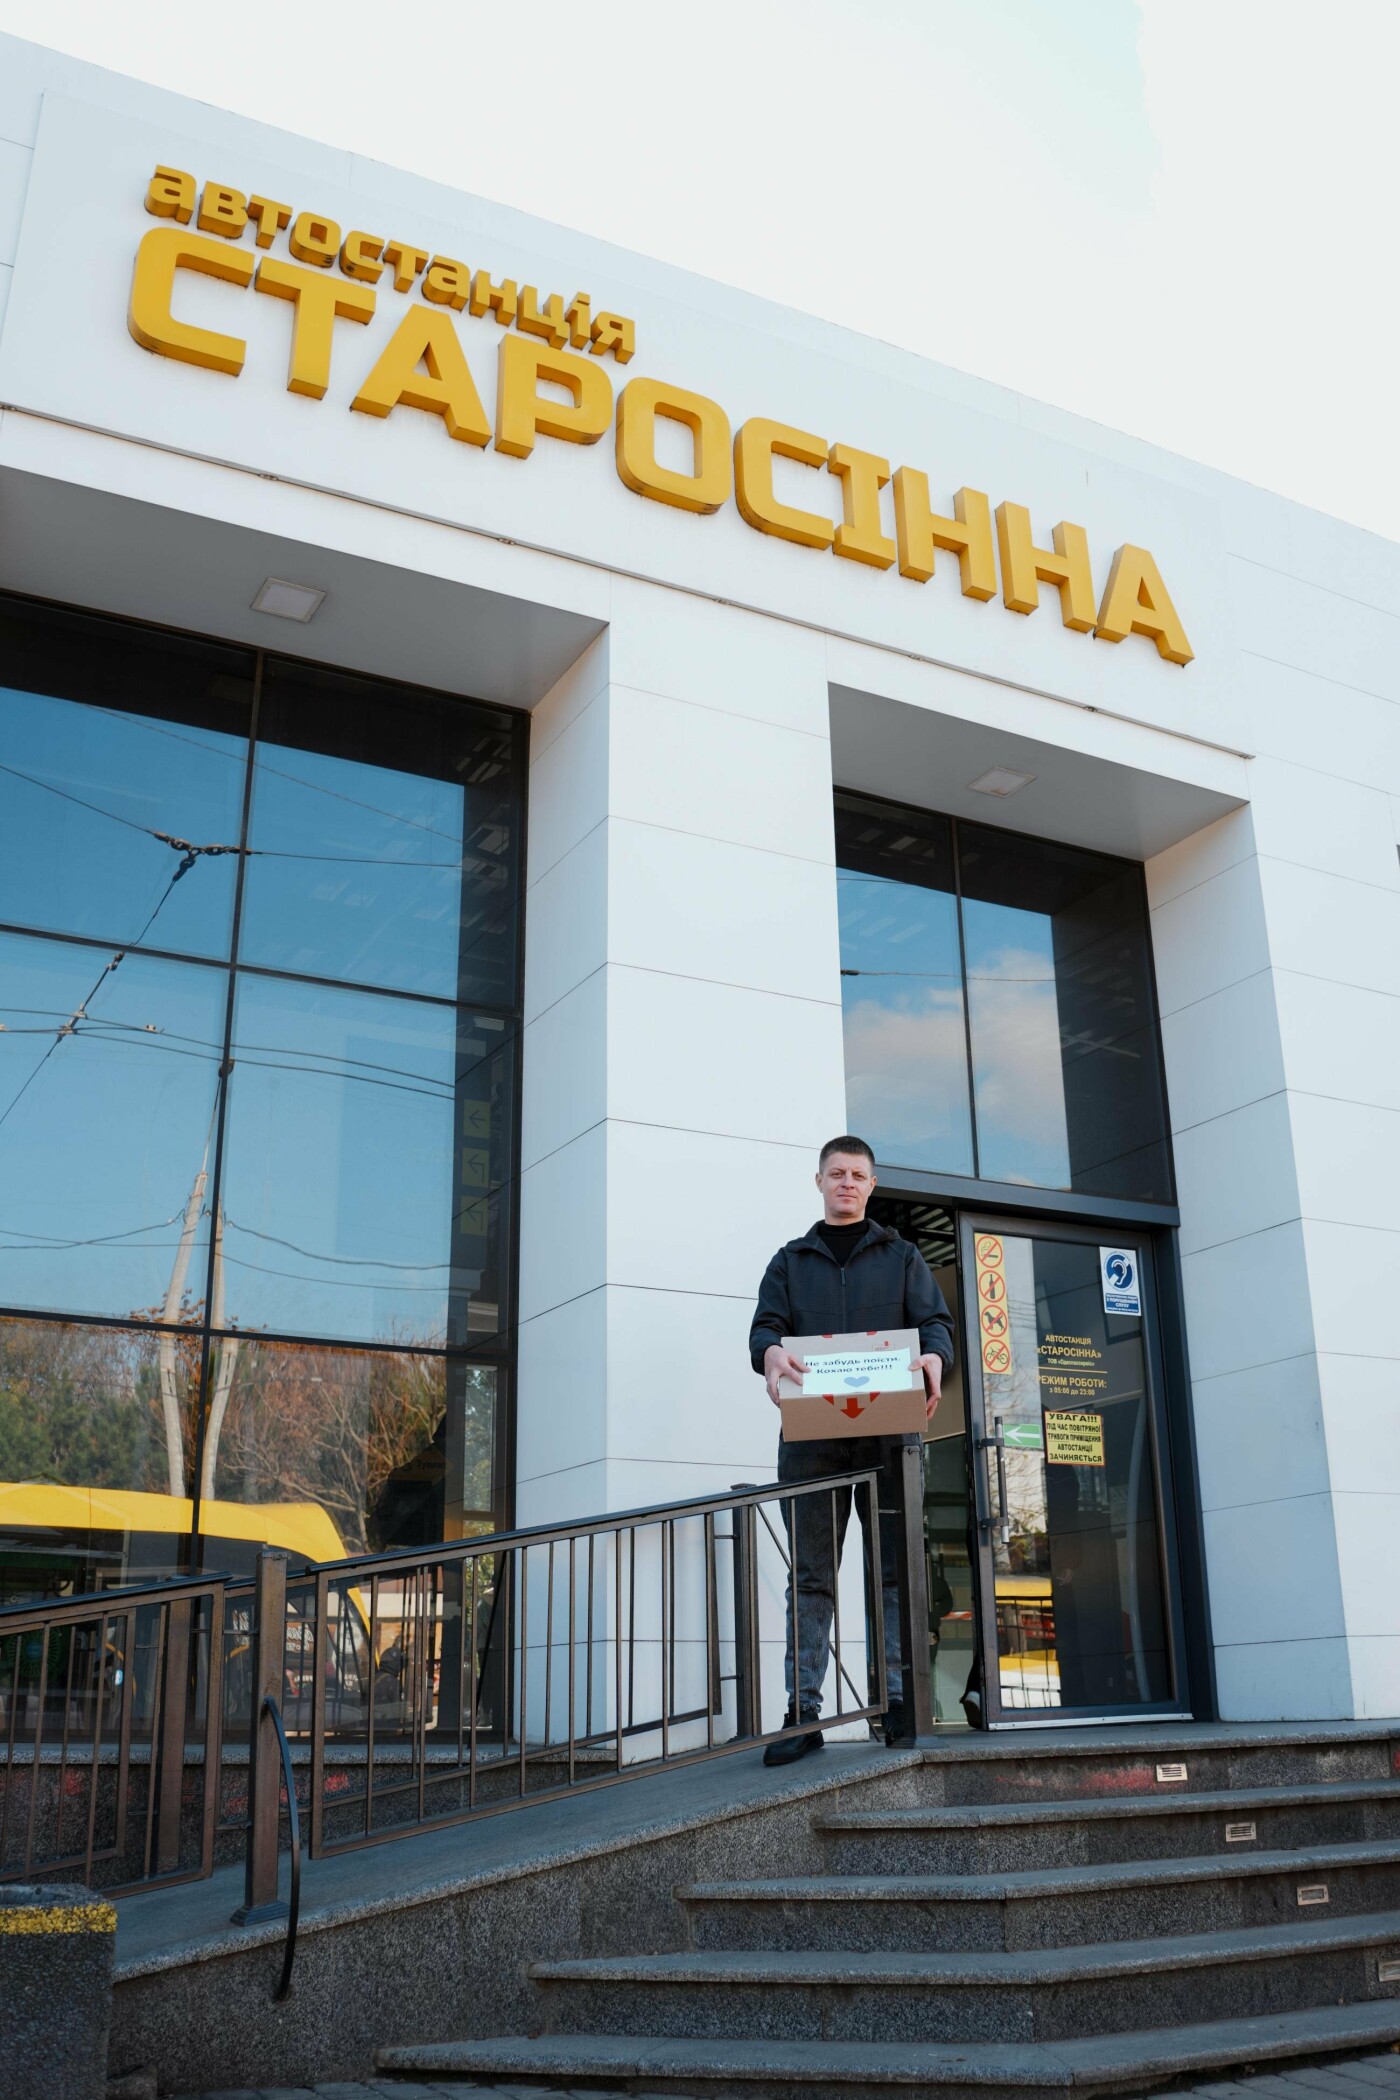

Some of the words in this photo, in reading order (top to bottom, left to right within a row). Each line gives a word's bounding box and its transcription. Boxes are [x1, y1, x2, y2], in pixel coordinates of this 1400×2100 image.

[145, 164, 635, 364] автостанція
[128, 227, 1195, 667] СТАРОСІННА
[1045, 1334, 1092, 1346] АВТОСТАНЦІЯ
[1035, 1345, 1102, 1359] «СТАРОСІННА»
[855, 1364, 892, 1372] тебе!!!
[1035, 1375, 1067, 1386] РЕЖИМ
[1069, 1377, 1107, 1389] РОБОТИ:
[1049, 1413, 1097, 1423] УВАГА!!!
[1046, 1422, 1056, 1431] ПІД
[1057, 1422, 1069, 1431] ЧАС
[1069, 1424, 1100, 1433] ПОВІТРЯНОЇ
[1047, 1432, 1069, 1441] ТРИВОГИ
[1069, 1434, 1101, 1443] ПРИМІЩЕННЯ
[1049, 1453, 1103, 1463] ЗАЧИНЯЄТЬСЯ
